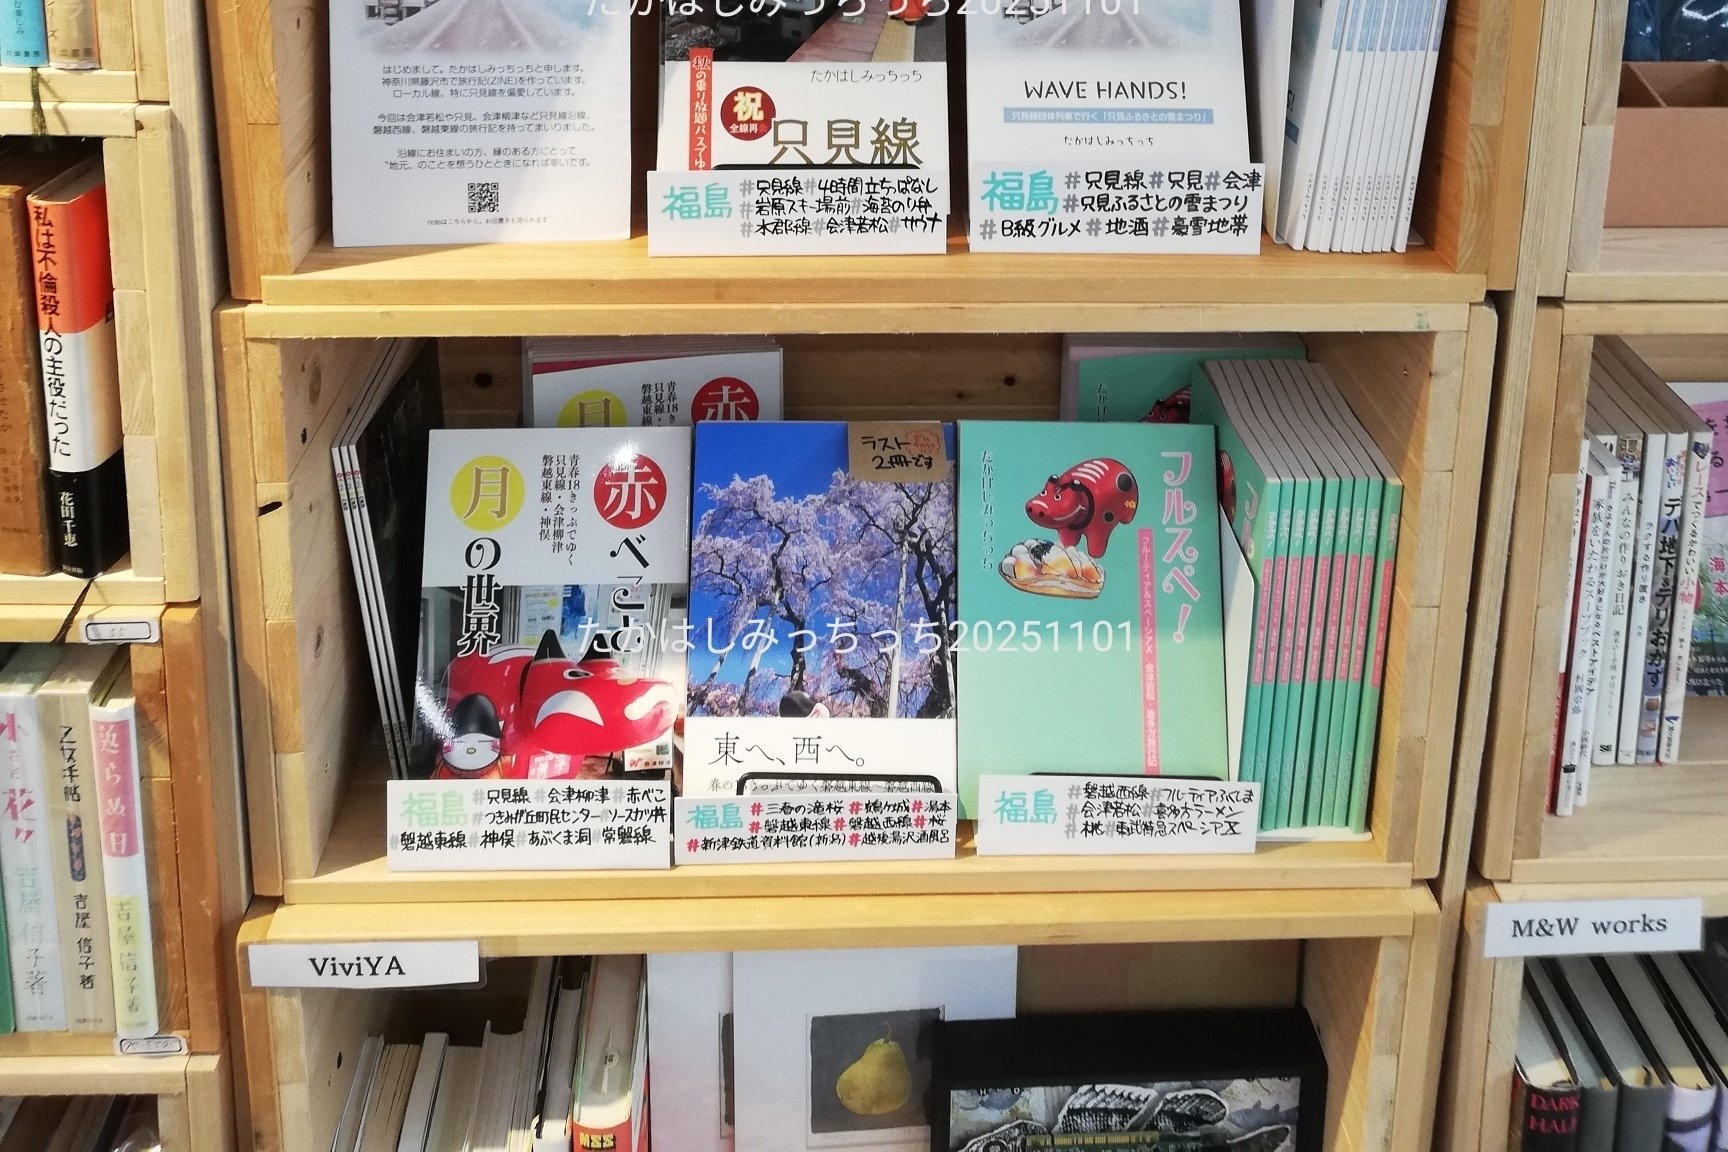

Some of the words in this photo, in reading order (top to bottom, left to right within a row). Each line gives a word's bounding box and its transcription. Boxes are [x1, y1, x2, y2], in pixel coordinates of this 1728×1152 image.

[810, 69, 923, 84] たかはしみっちっち
[1024, 80, 1088, 99] WAVE
[1096, 80, 1187, 100] HANDS!
[732, 91, 765, 122] 祝
[768, 116, 925, 166] 只見線
[1063, 134, 1155, 147] たかはしみっちっち
[662, 182, 733, 222] 福島
[980, 169, 1060, 216] 福島
[861, 436, 911, 452] ラスト
[872, 454, 934, 470] 2冊です
[552, 454, 567, 554] 只見線・会津柳津
[566, 454, 581, 567] 青春18きっぷでゆく
[457, 465, 512, 658] 月の世界
[708, 731, 866, 768] 東へ、西へ。
[399, 790, 469, 827] 福島
[686, 803, 744, 830] 福島
[994, 788, 1058, 825] 福島
[1511, 917, 1580, 938] M&W
[1591, 913, 1668, 935] works
[308, 954, 407, 978] ViviYA
